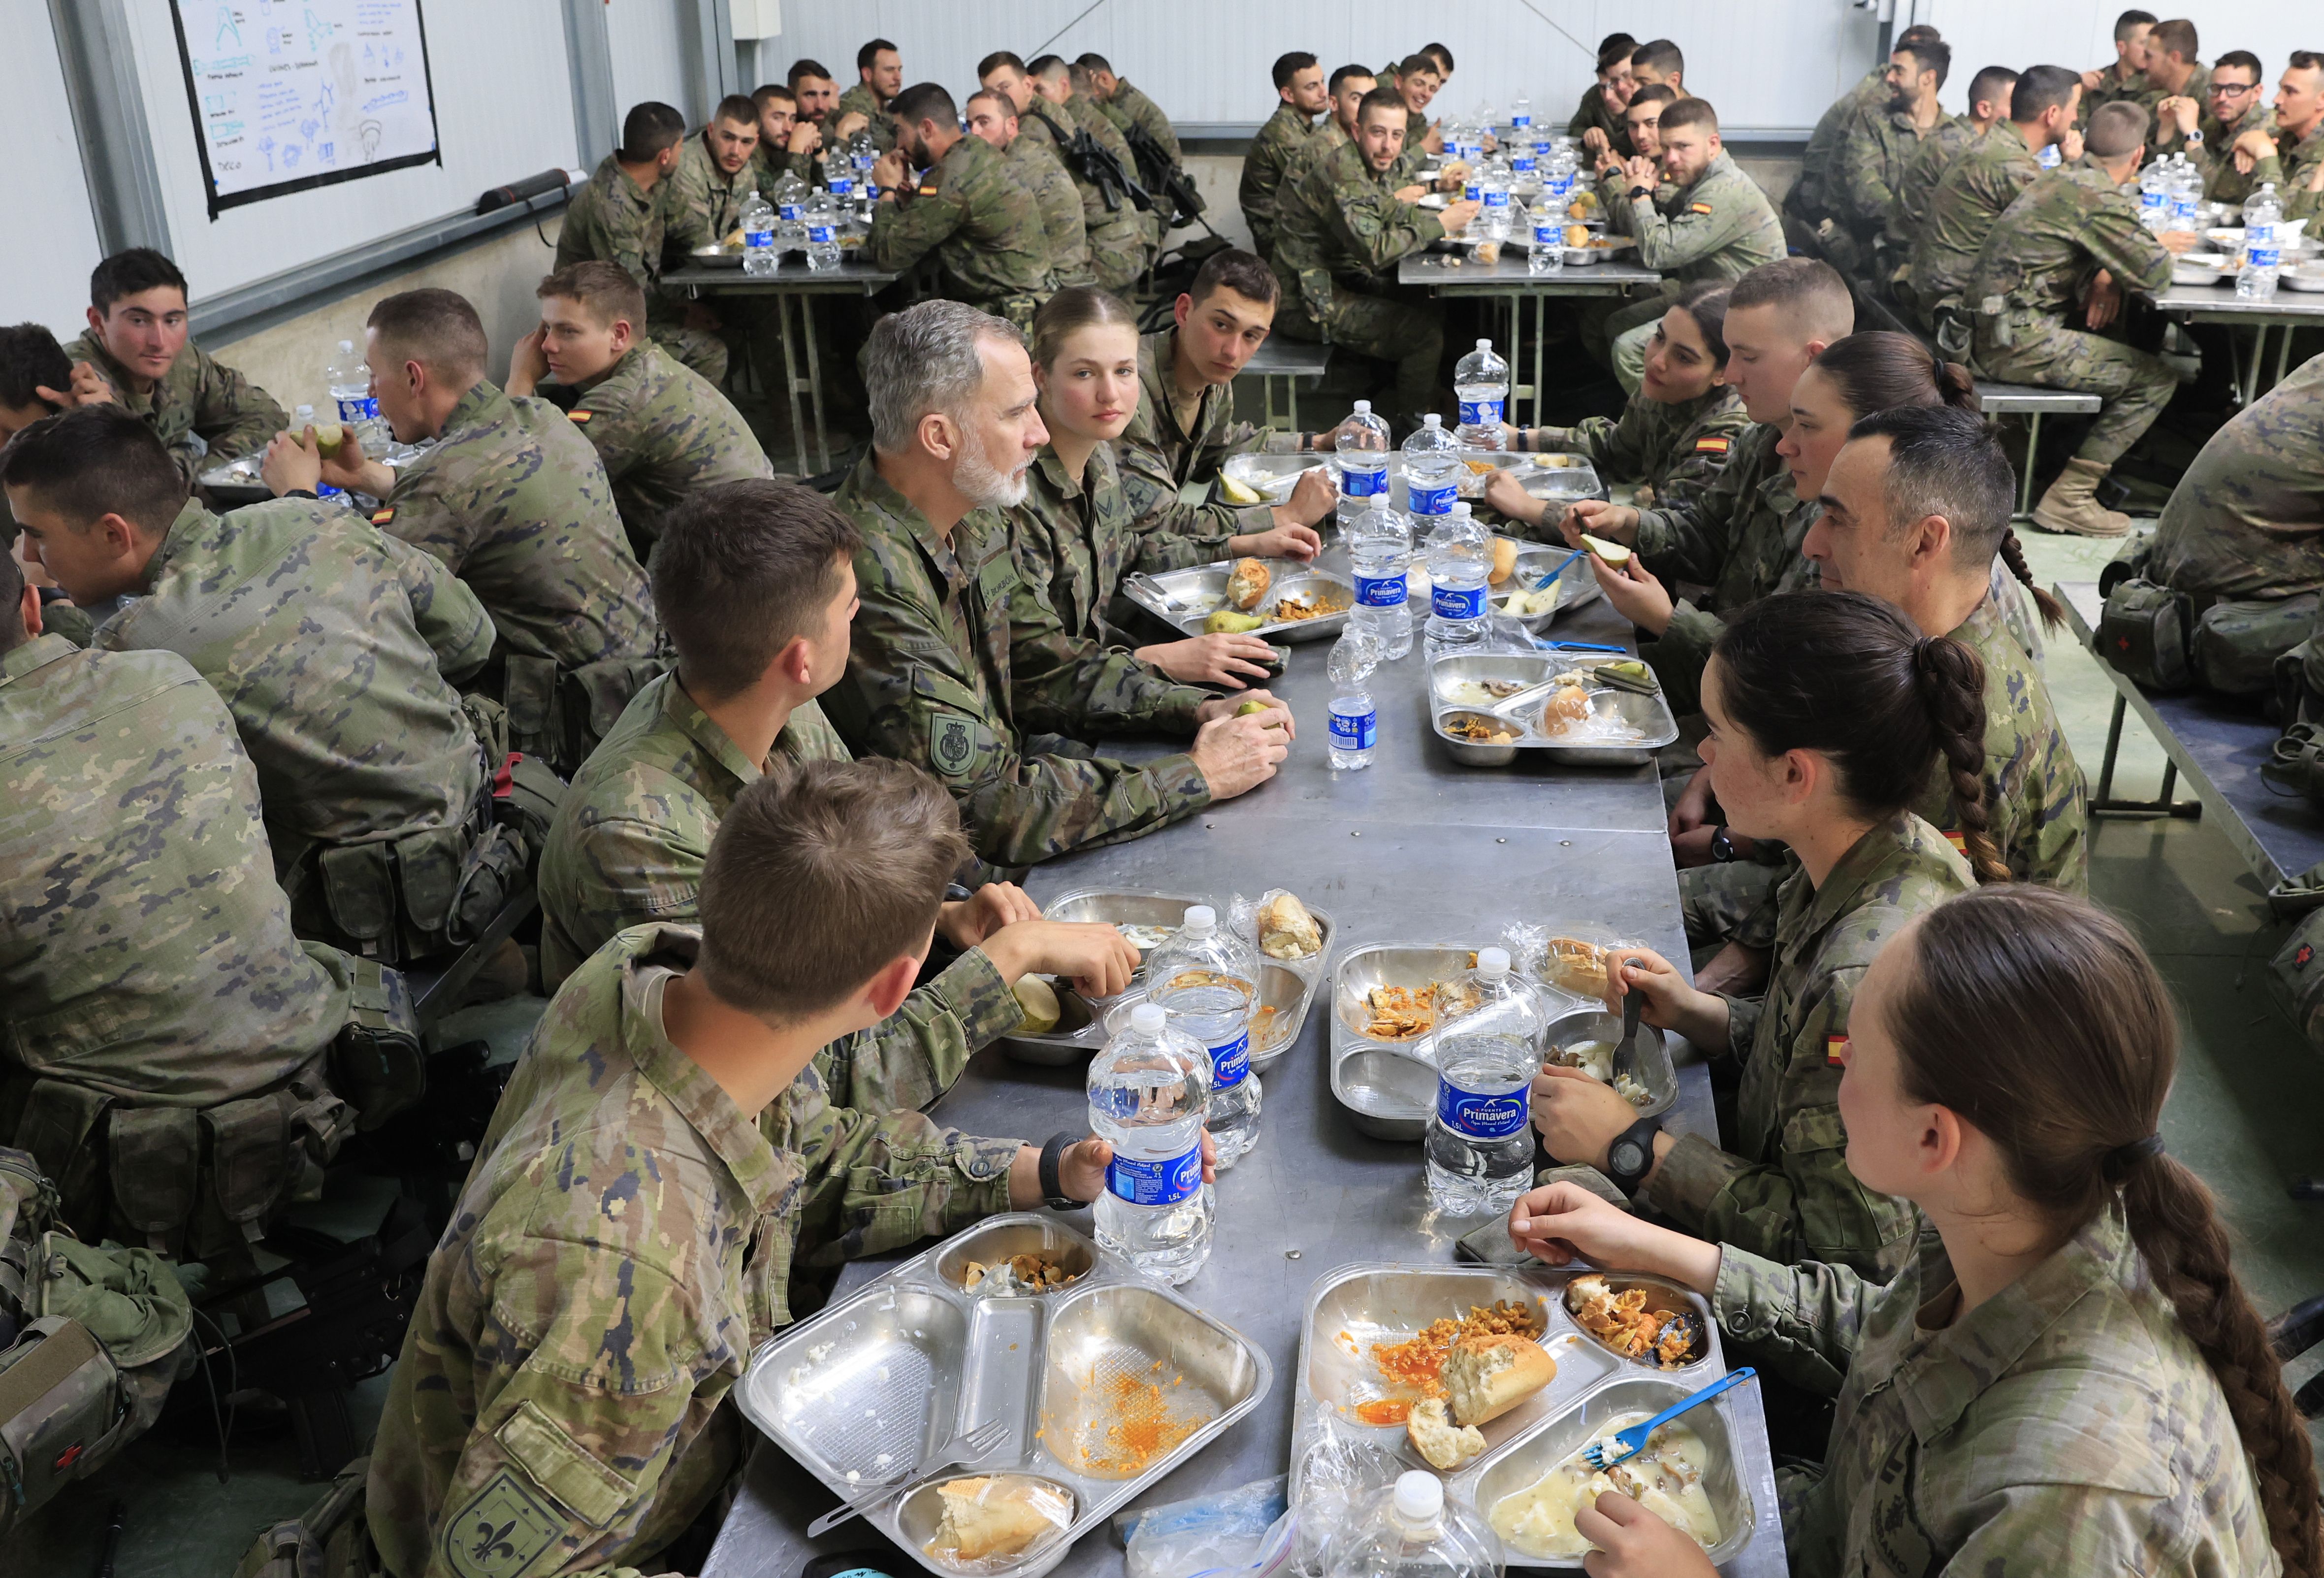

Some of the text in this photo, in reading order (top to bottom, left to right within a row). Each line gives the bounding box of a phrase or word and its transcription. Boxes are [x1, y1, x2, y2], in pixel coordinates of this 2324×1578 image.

[991, 573, 1015, 596] BORBÓN
[1370, 587, 1401, 596] Primavera
[1436, 597, 1466, 609] Primavera
[1212, 1081, 1222, 1089] ,5L
[1464, 1108, 1516, 1121] Primavera
[1452, 1120, 1463, 1131] 1,5L
[1168, 1192, 1181, 1202] 1,5L
